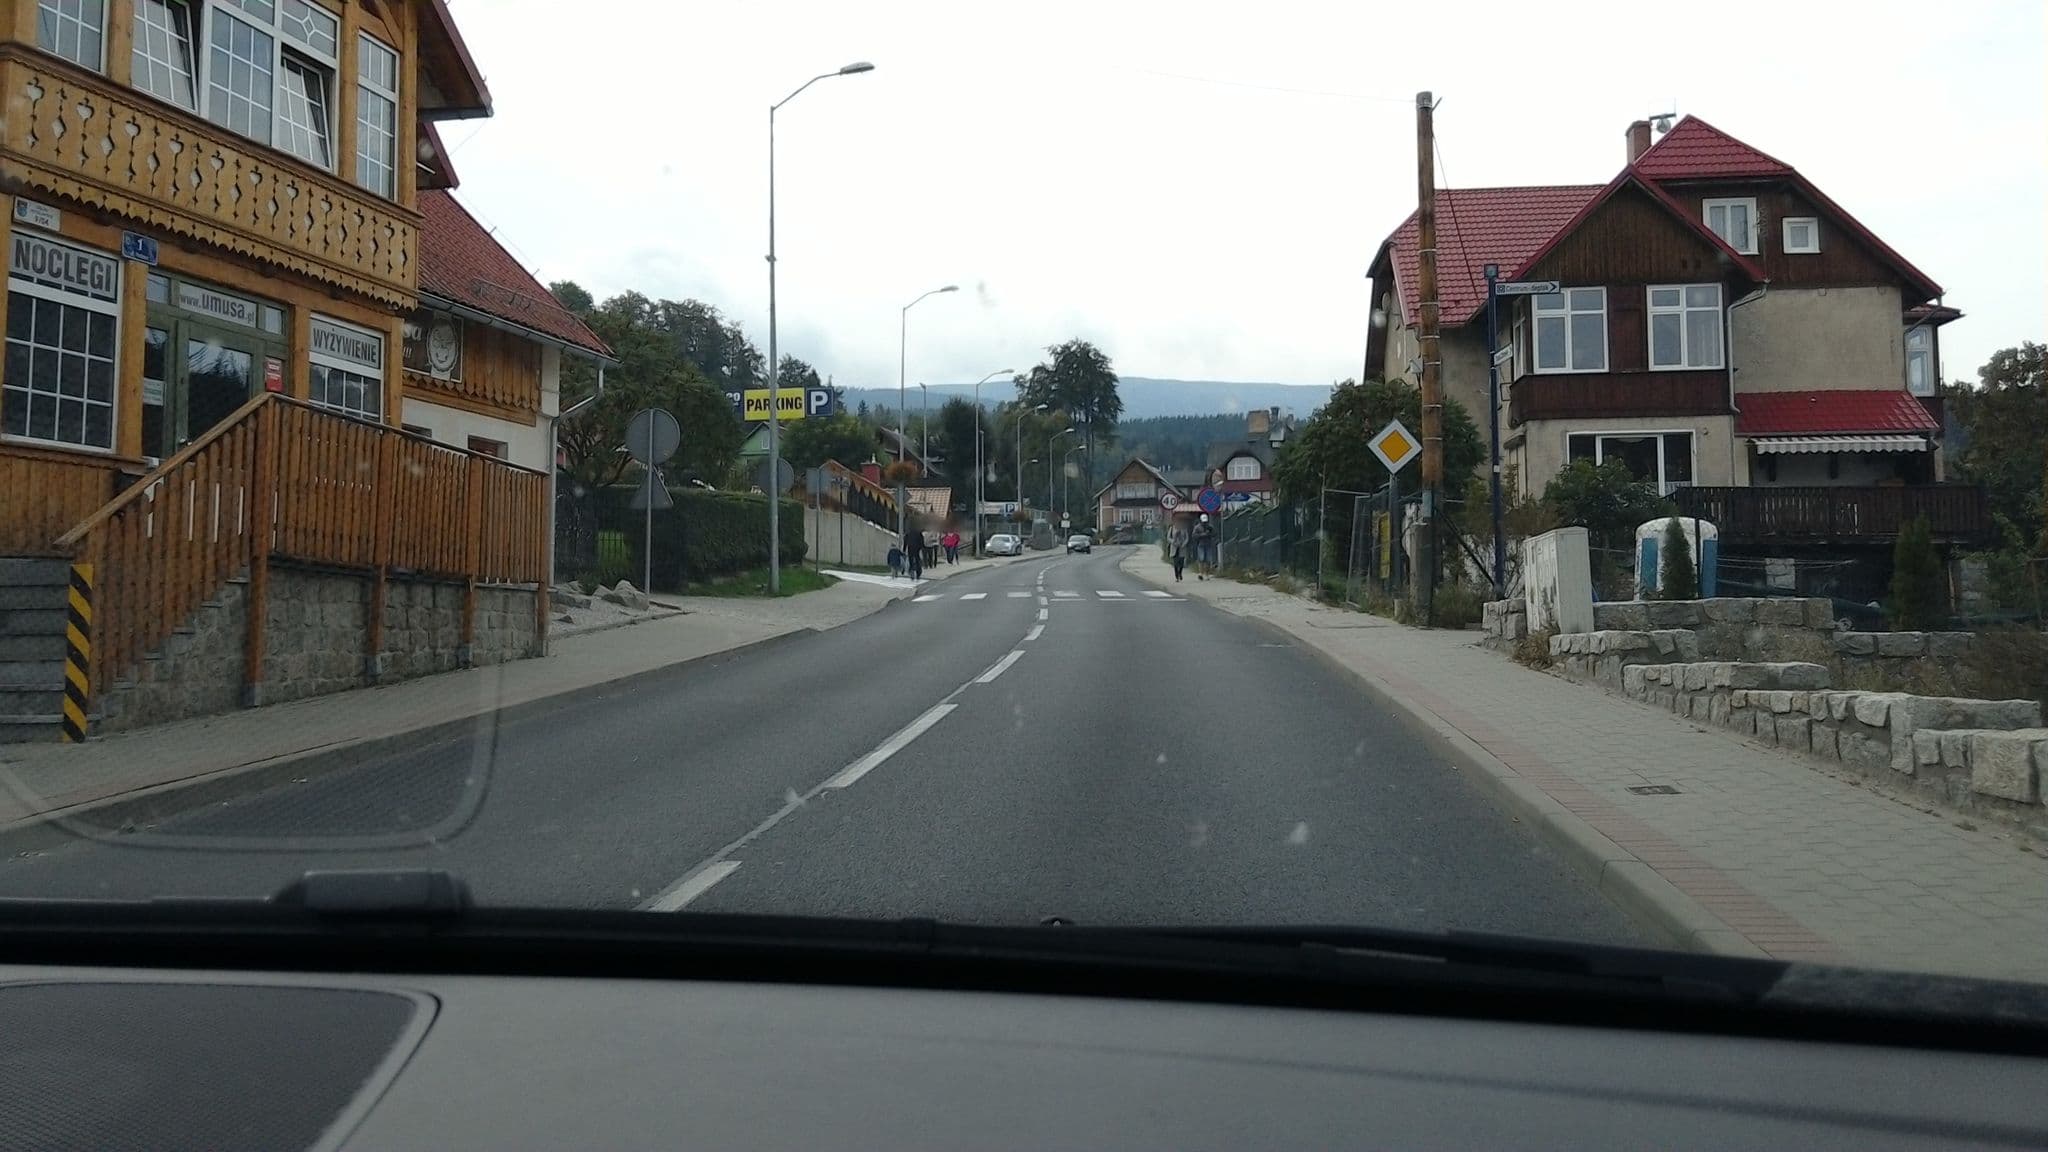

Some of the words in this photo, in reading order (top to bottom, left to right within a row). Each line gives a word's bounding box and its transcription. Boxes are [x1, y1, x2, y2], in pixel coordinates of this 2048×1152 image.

[137, 238, 143, 251] 1
[15, 238, 112, 293] NOCLEGI
[179, 292, 255, 324] www.umusa.pl
[312, 327, 377, 363] WYŻYWIENIE
[810, 391, 828, 415] P
[1163, 497, 1177, 505] 40
